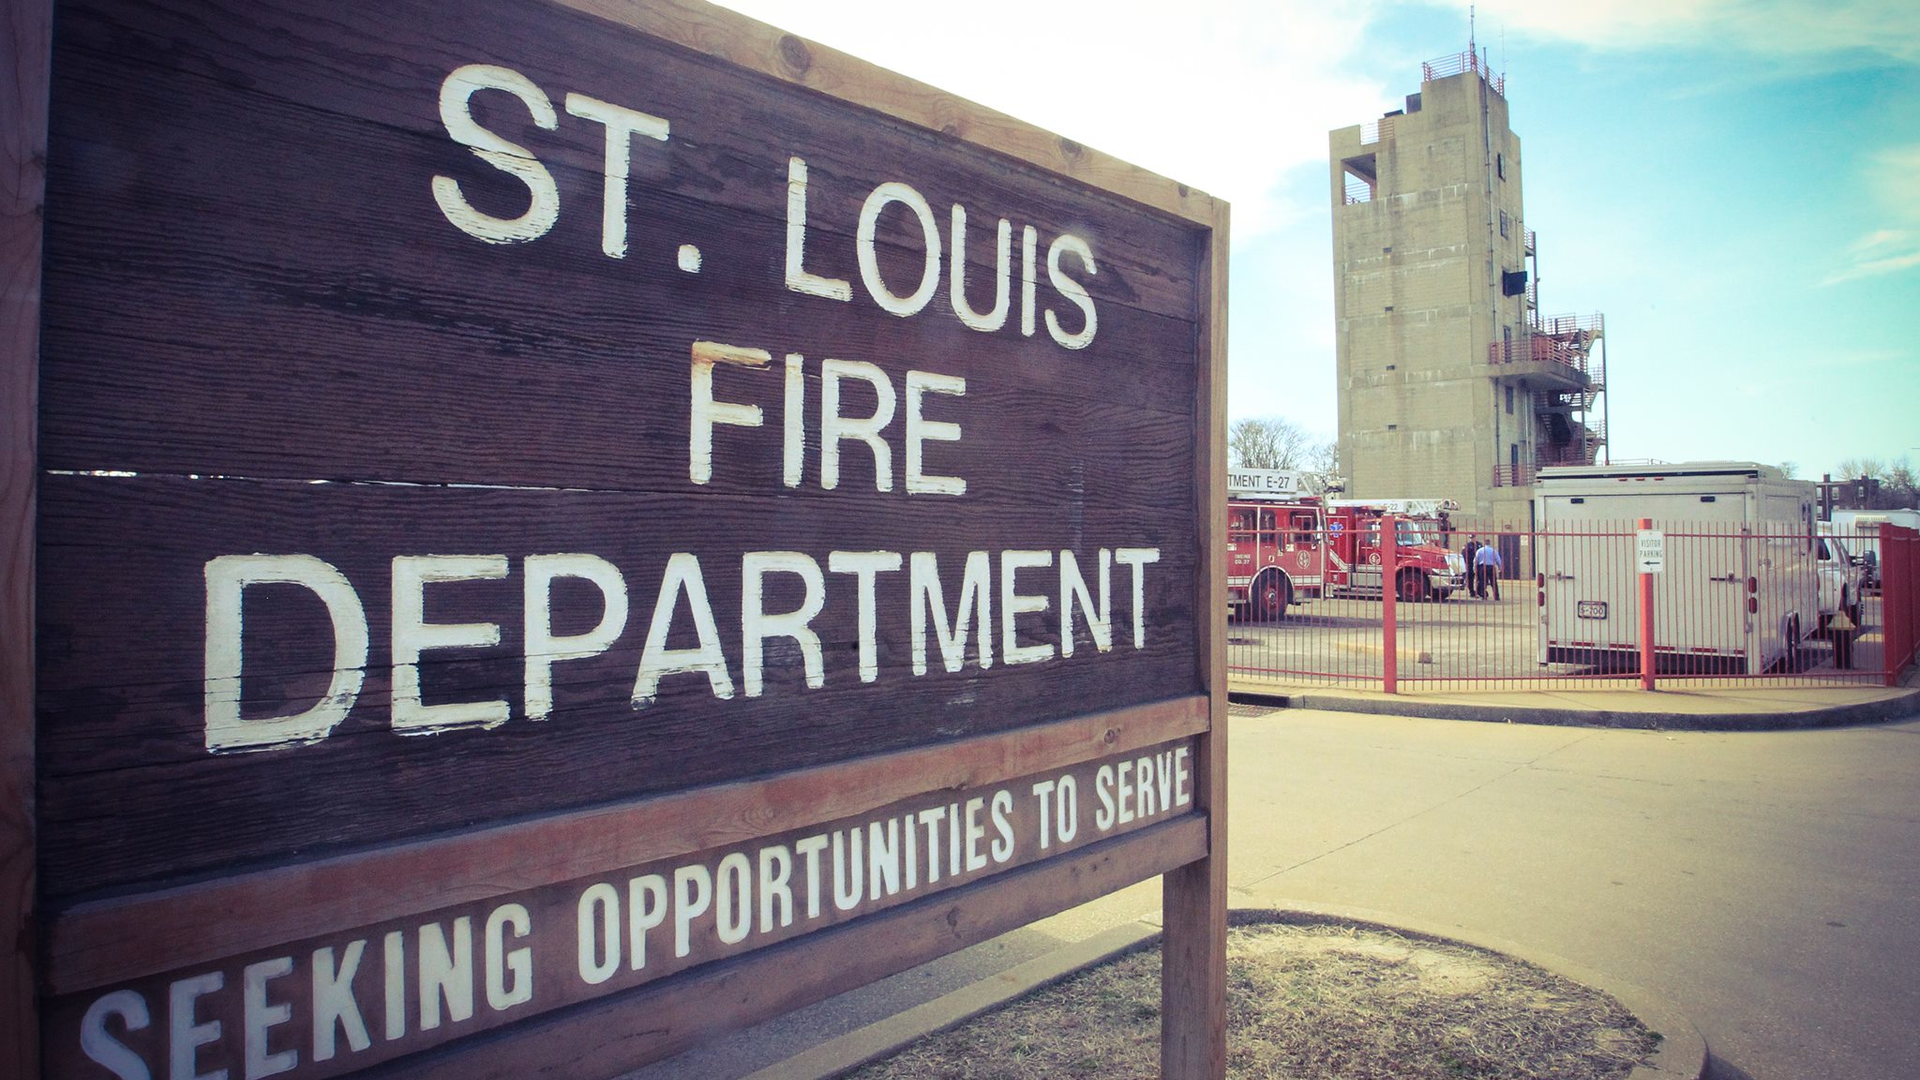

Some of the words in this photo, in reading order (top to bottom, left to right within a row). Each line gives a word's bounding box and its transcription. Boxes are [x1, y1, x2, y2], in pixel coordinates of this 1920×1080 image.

[432, 64, 701, 272] ST.
[785, 156, 1098, 350] LOUIS
[689, 340, 967, 496] FIRE
[1266, 476, 1290, 489] E-27
[1639, 549, 1663, 558] PARKING
[1640, 539, 1661, 548] VISITOR
[203, 548, 1161, 754] DEPARTMENT
[80, 902, 534, 1080] SEEKING
[578, 790, 1016, 985] OPPORTUNITIES
[1033, 774, 1078, 849] TO
[1096, 746, 1191, 832] SERVE
